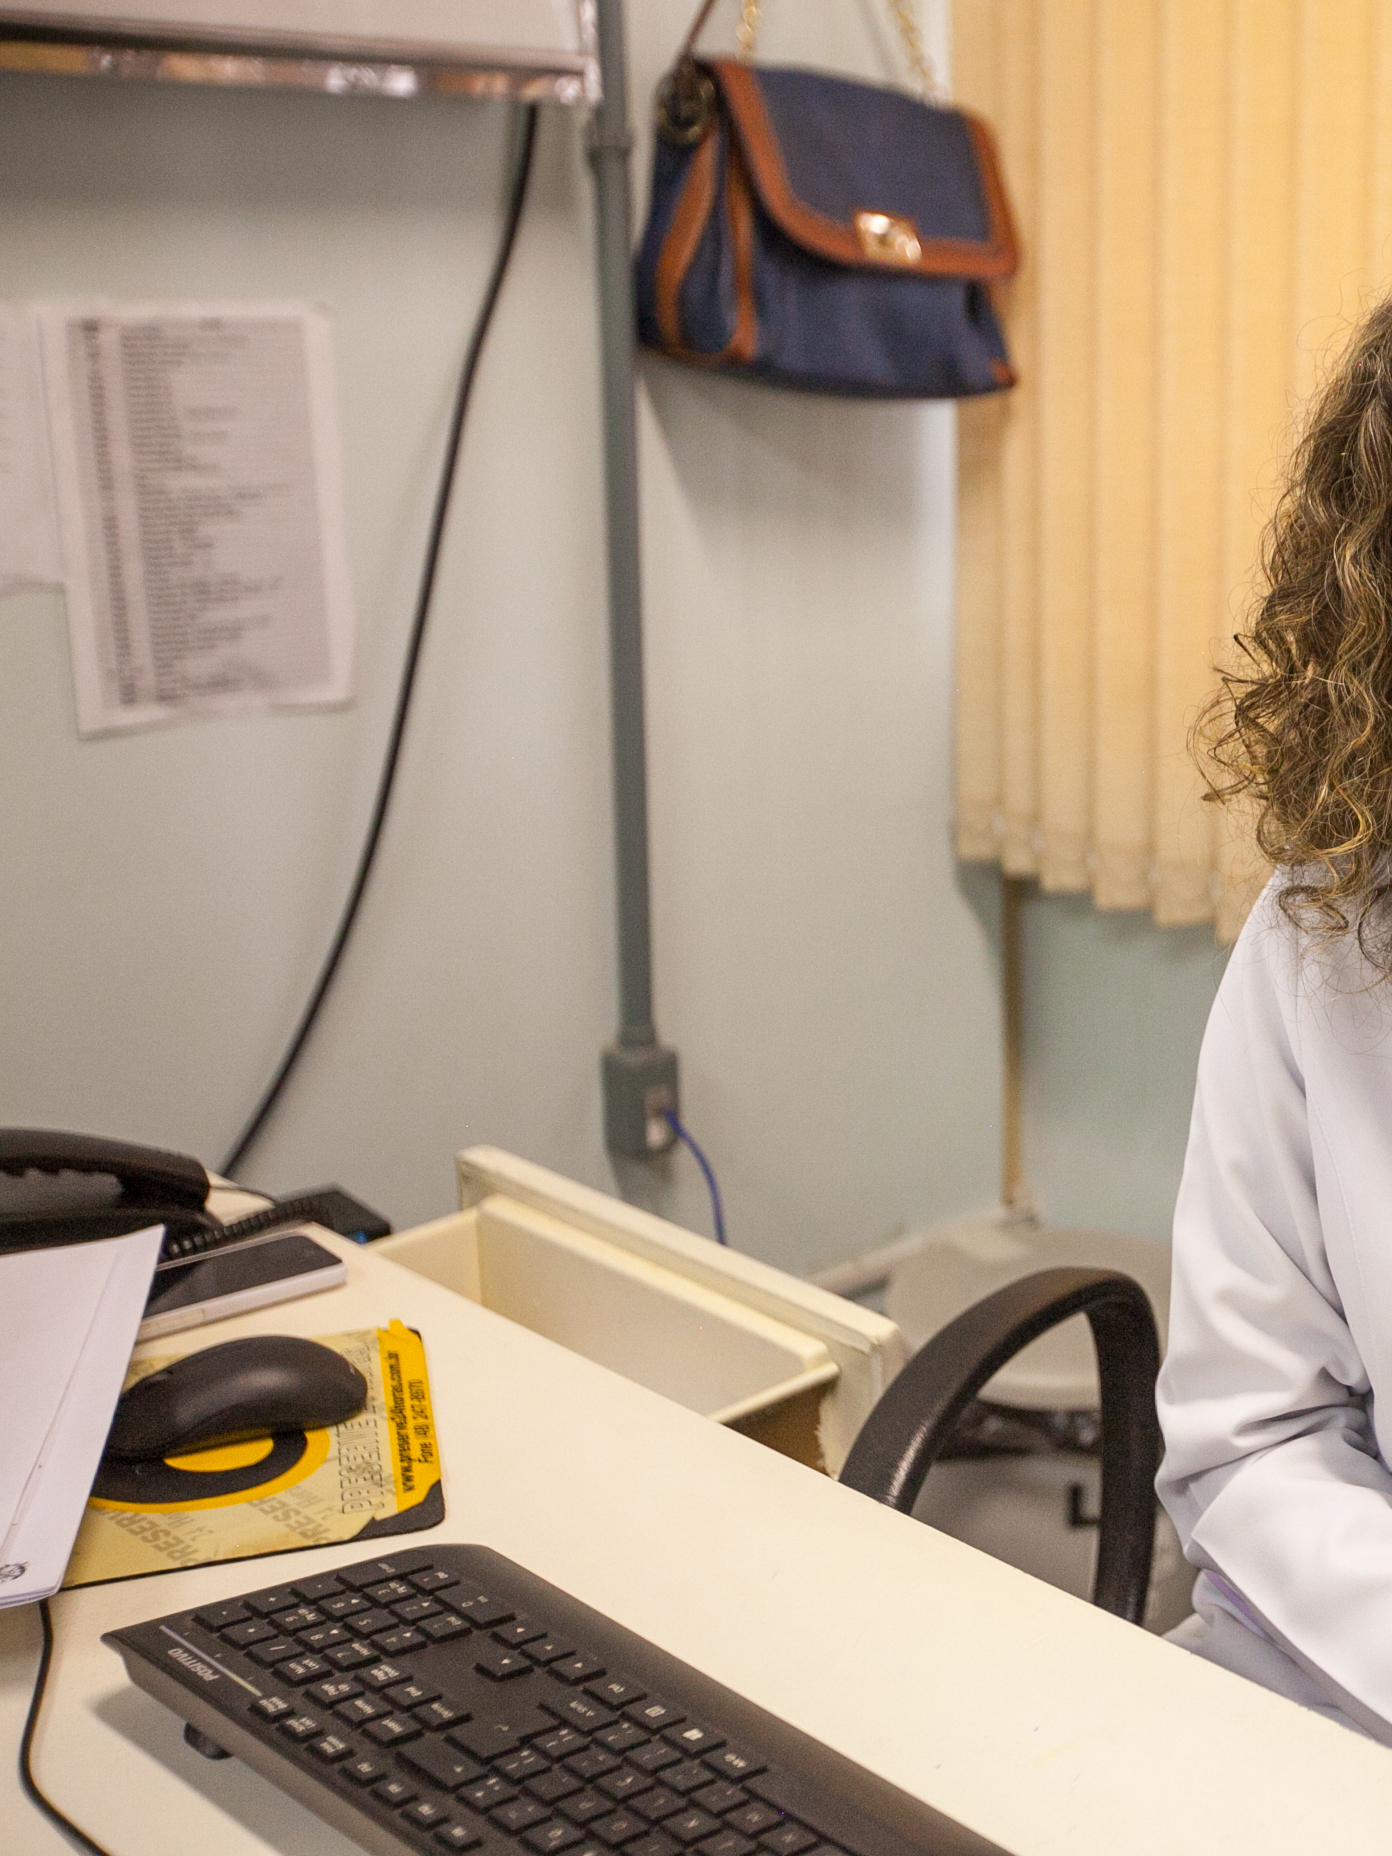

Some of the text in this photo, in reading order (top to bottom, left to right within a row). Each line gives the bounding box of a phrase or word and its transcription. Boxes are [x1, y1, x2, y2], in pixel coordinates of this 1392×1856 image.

[336, 1416, 385, 1515] PRESERVE
[417, 1441, 435, 1465] Fone
[167, 1646, 221, 1682] POSITIVO
